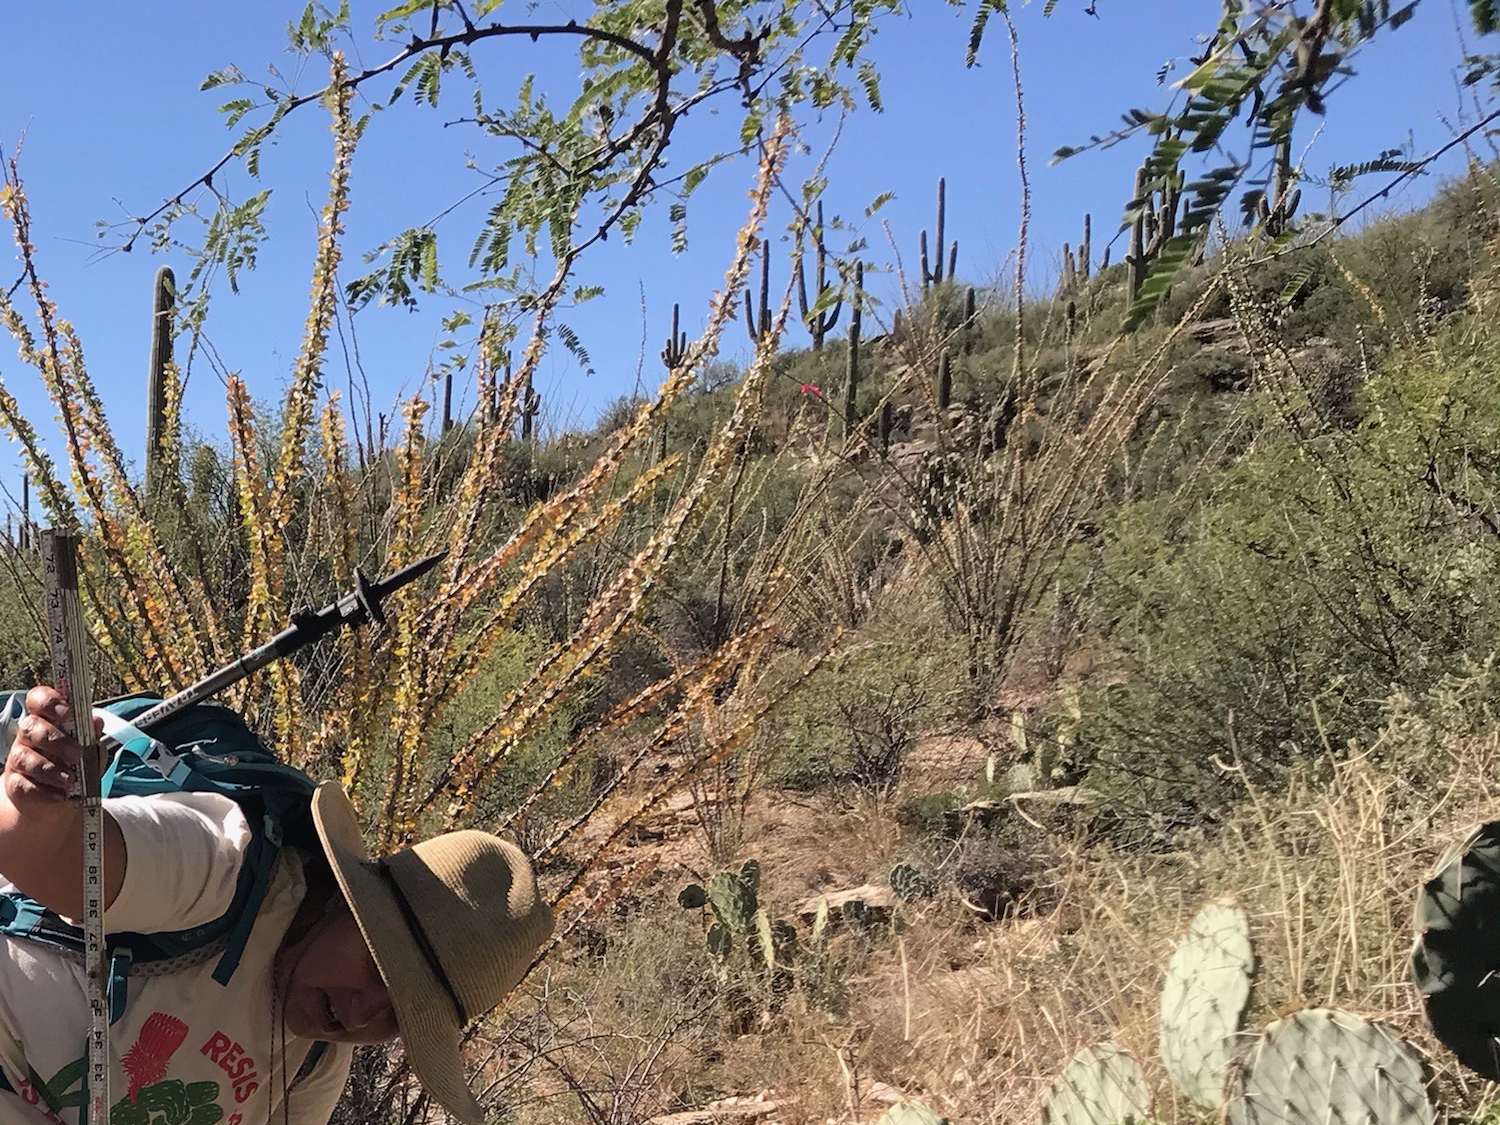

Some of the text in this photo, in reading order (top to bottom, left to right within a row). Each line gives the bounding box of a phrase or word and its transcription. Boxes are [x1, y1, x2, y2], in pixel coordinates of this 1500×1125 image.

[46, 553, 55, 574] 72
[50, 588, 59, 608] 73
[54, 624, 63, 643] 74
[58, 659, 67, 679] 75
[88, 831, 97, 851] 40
[88, 865, 98, 884] 39
[89, 899, 98, 918] 38
[89, 932, 98, 952] 37
[90, 999, 102, 1017] 35
[94, 1030, 103, 1050] 34
[94, 1063, 103, 1082] 33
